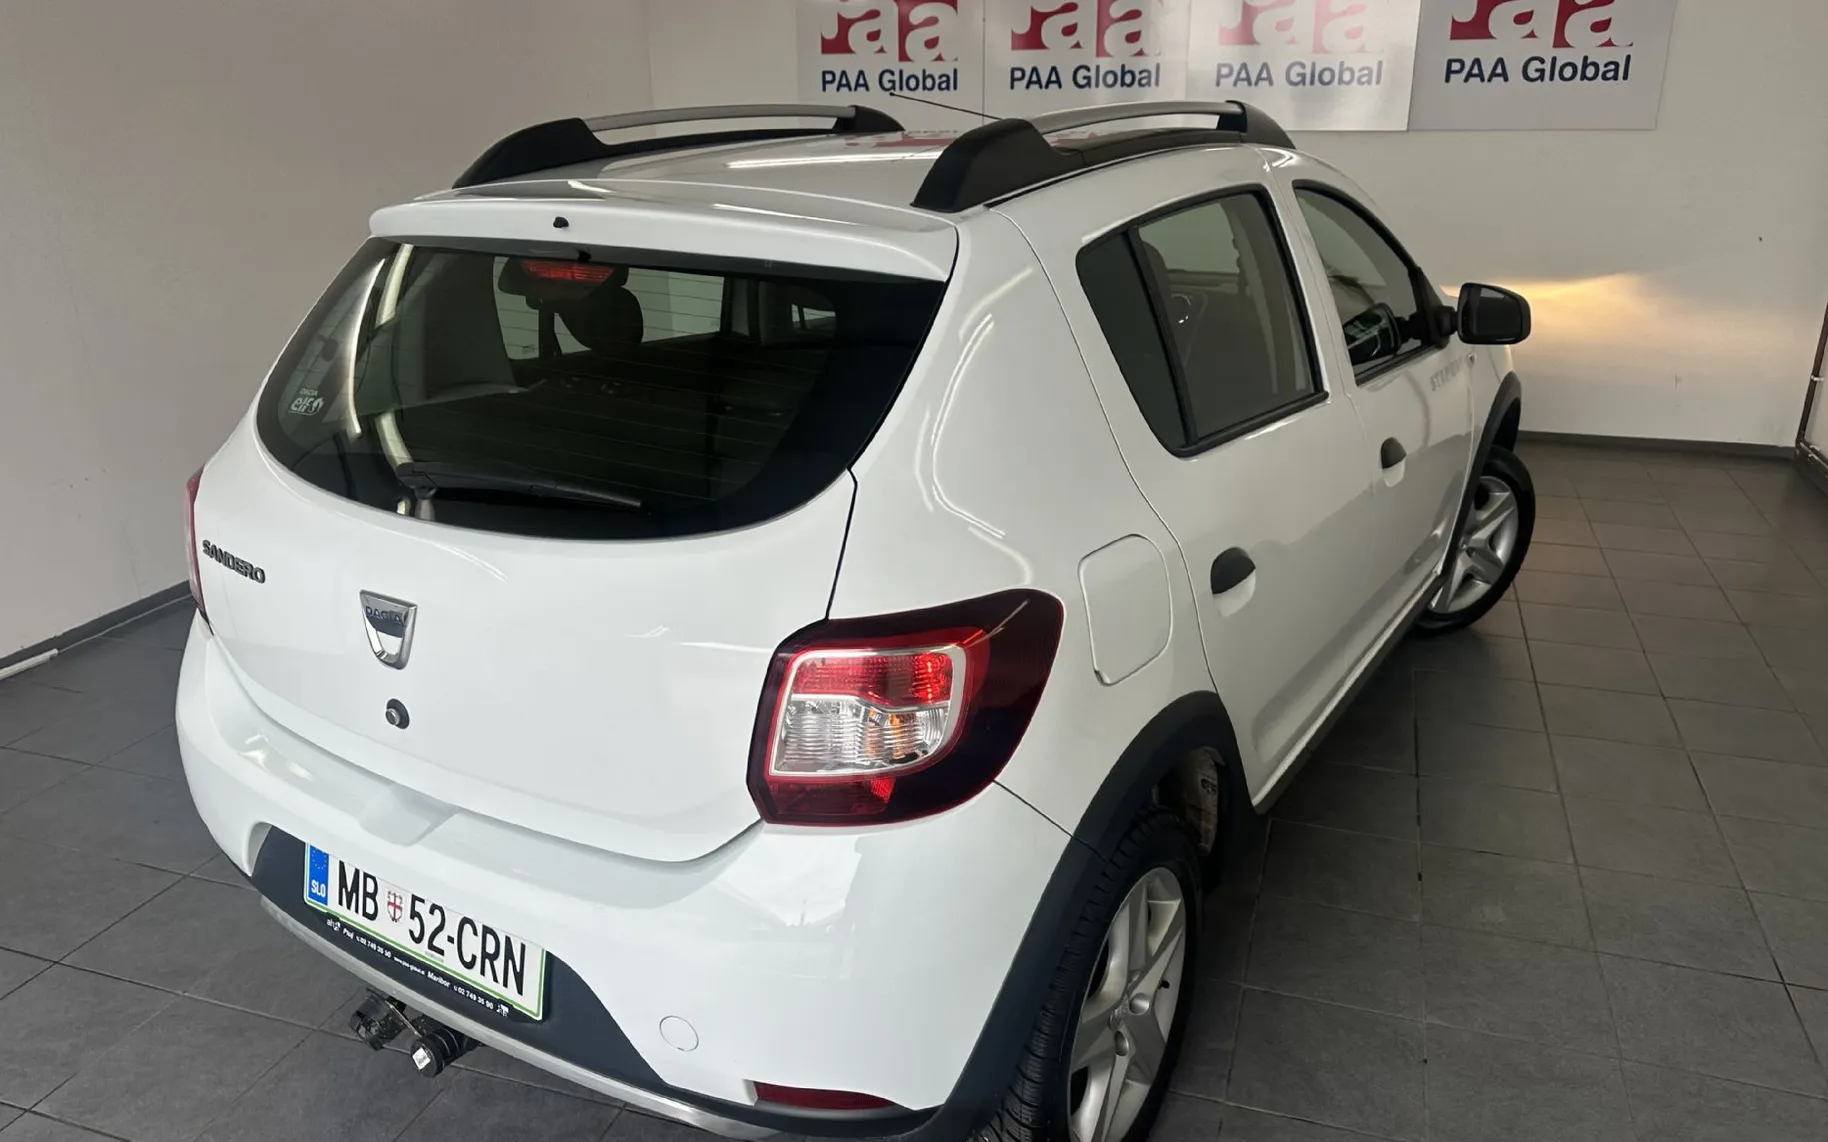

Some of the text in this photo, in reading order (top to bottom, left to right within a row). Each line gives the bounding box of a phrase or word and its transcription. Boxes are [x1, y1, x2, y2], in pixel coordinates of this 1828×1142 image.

[822, 68, 958, 92] PAA Global
[1010, 63, 1160, 90] PAA Global
[1216, 60, 1383, 87] PAA Global
[1445, 54, 1632, 84] PAA Global
[202, 539, 266, 584] SANDERO
[366, 605, 405, 627] DACIA
[311, 879, 326, 898] SLO
[338, 860, 526, 997] MB 52-CRN
[427, 971, 451, 988] Maribor
